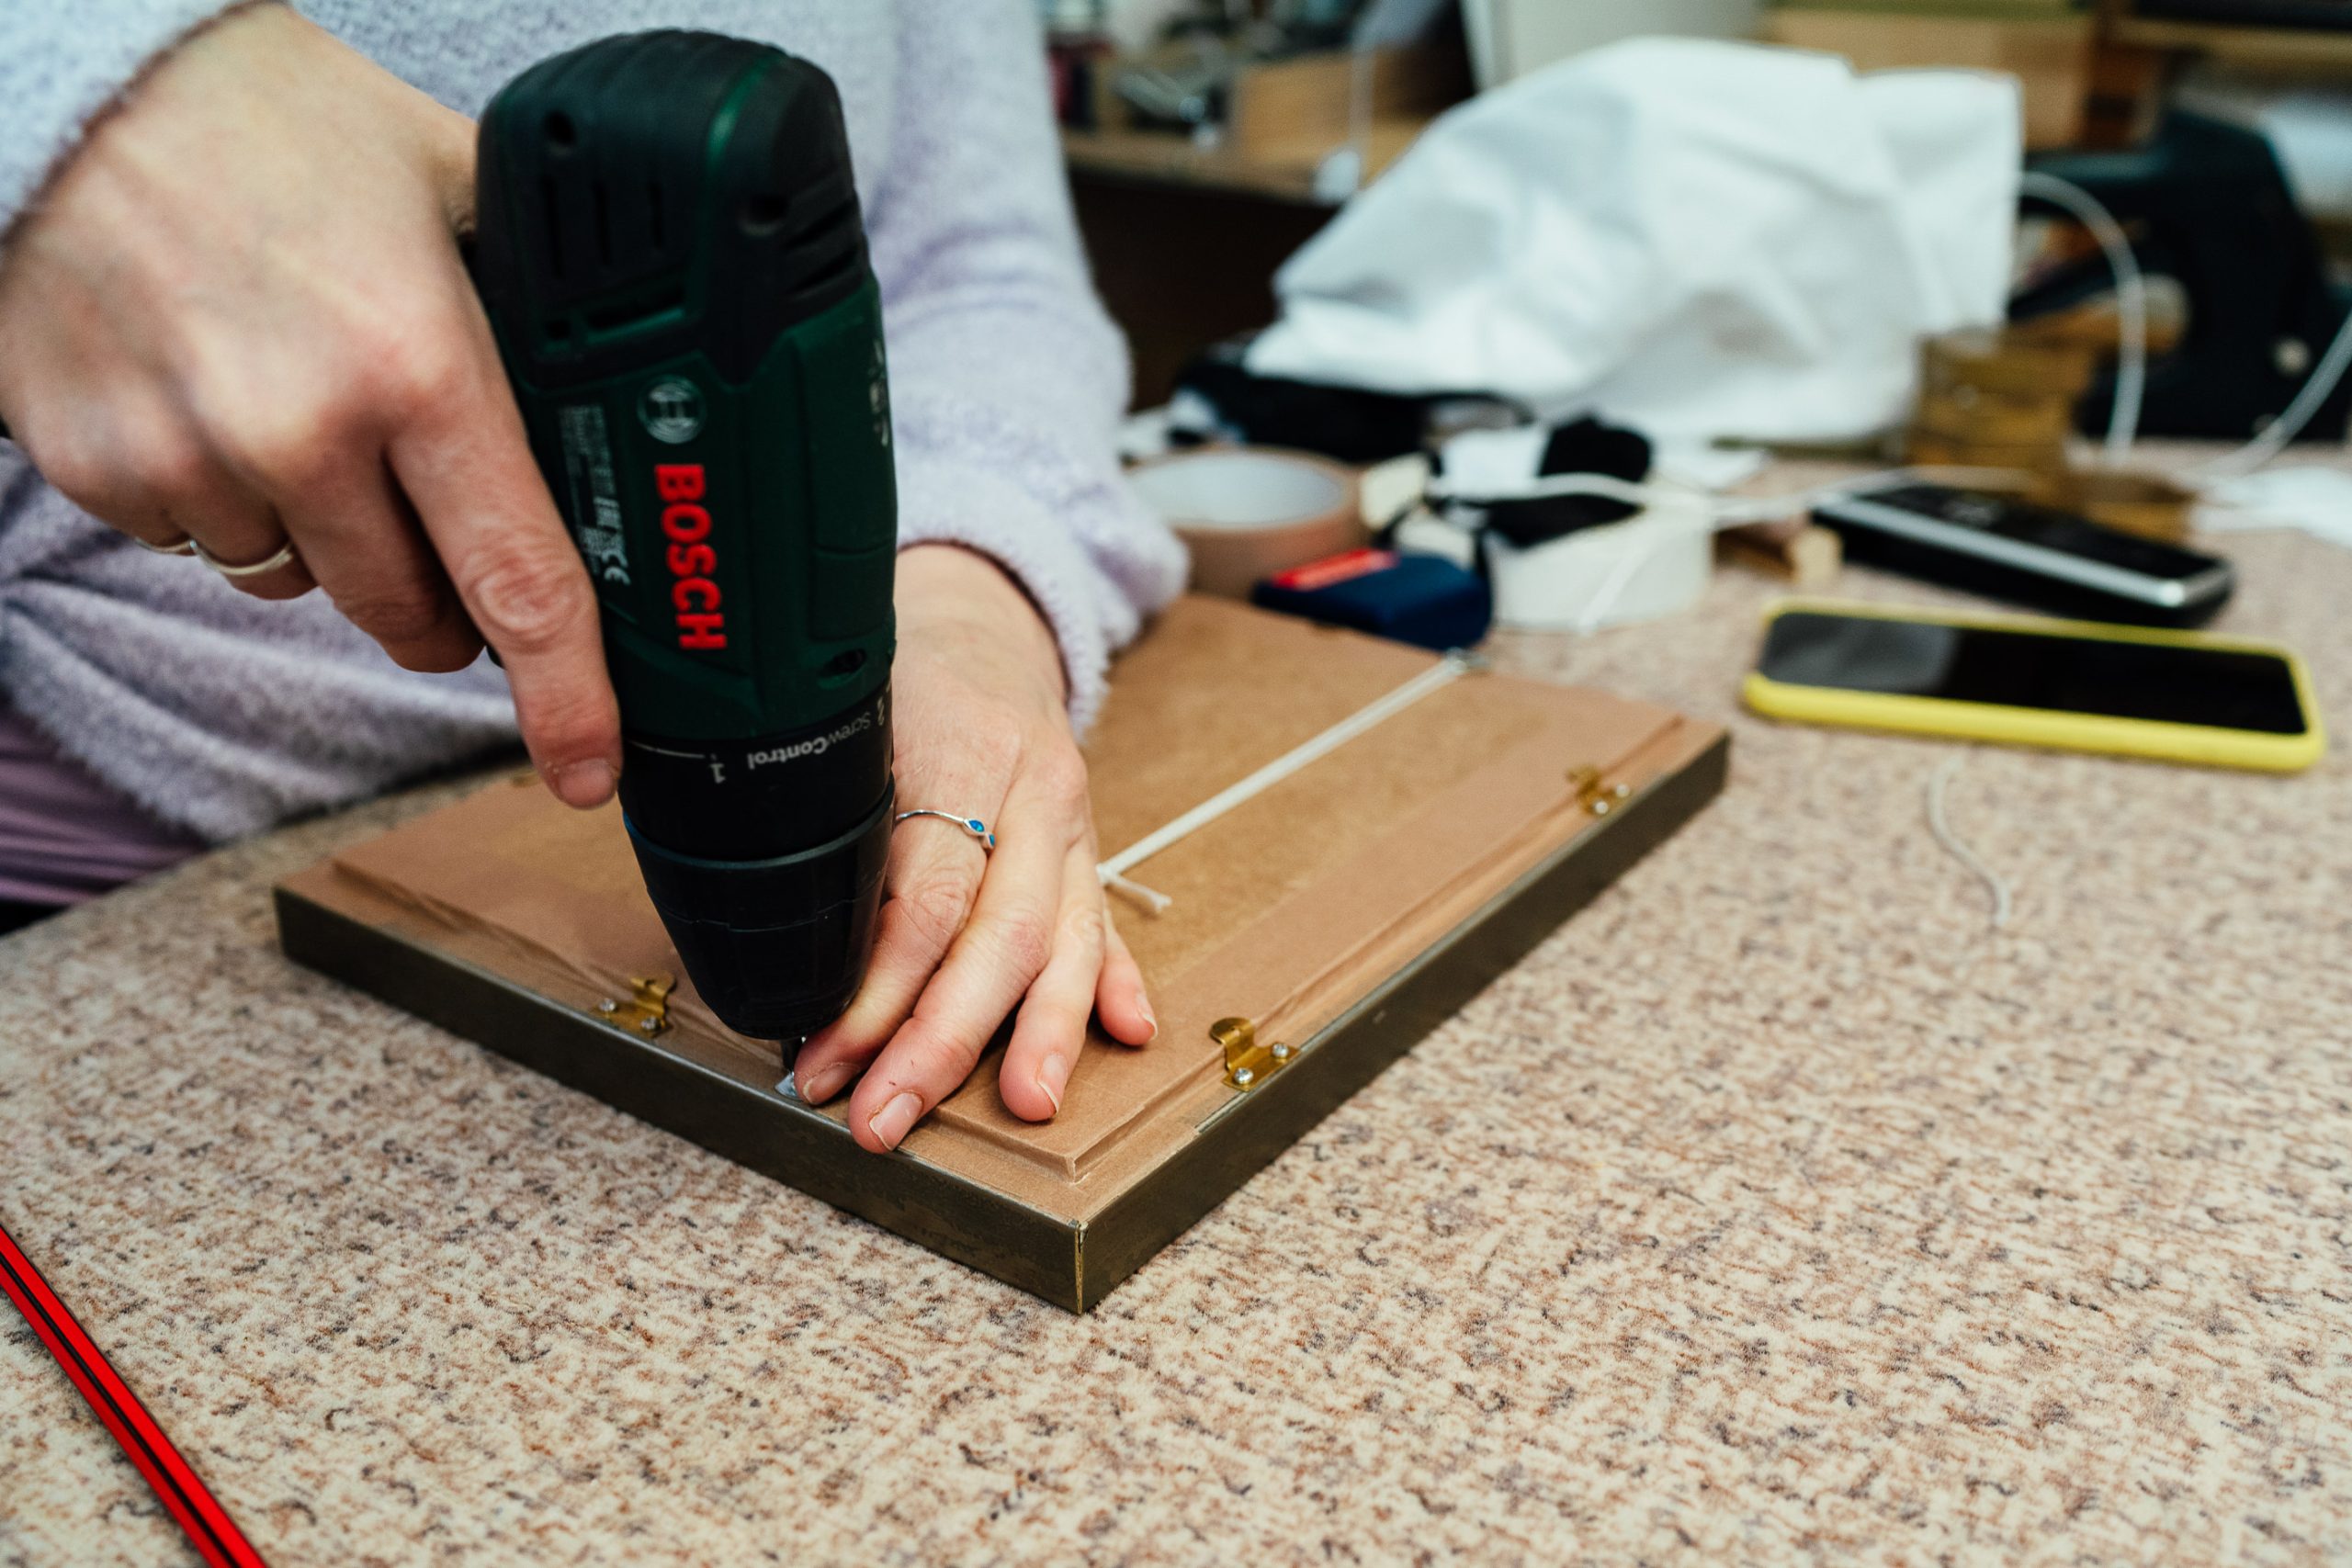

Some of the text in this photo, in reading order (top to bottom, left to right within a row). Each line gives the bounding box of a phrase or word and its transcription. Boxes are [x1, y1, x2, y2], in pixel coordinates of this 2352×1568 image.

[654, 463, 727, 649] BOSCH
[747, 712, 872, 769] ScrewControl
[709, 762, 726, 784] 1
